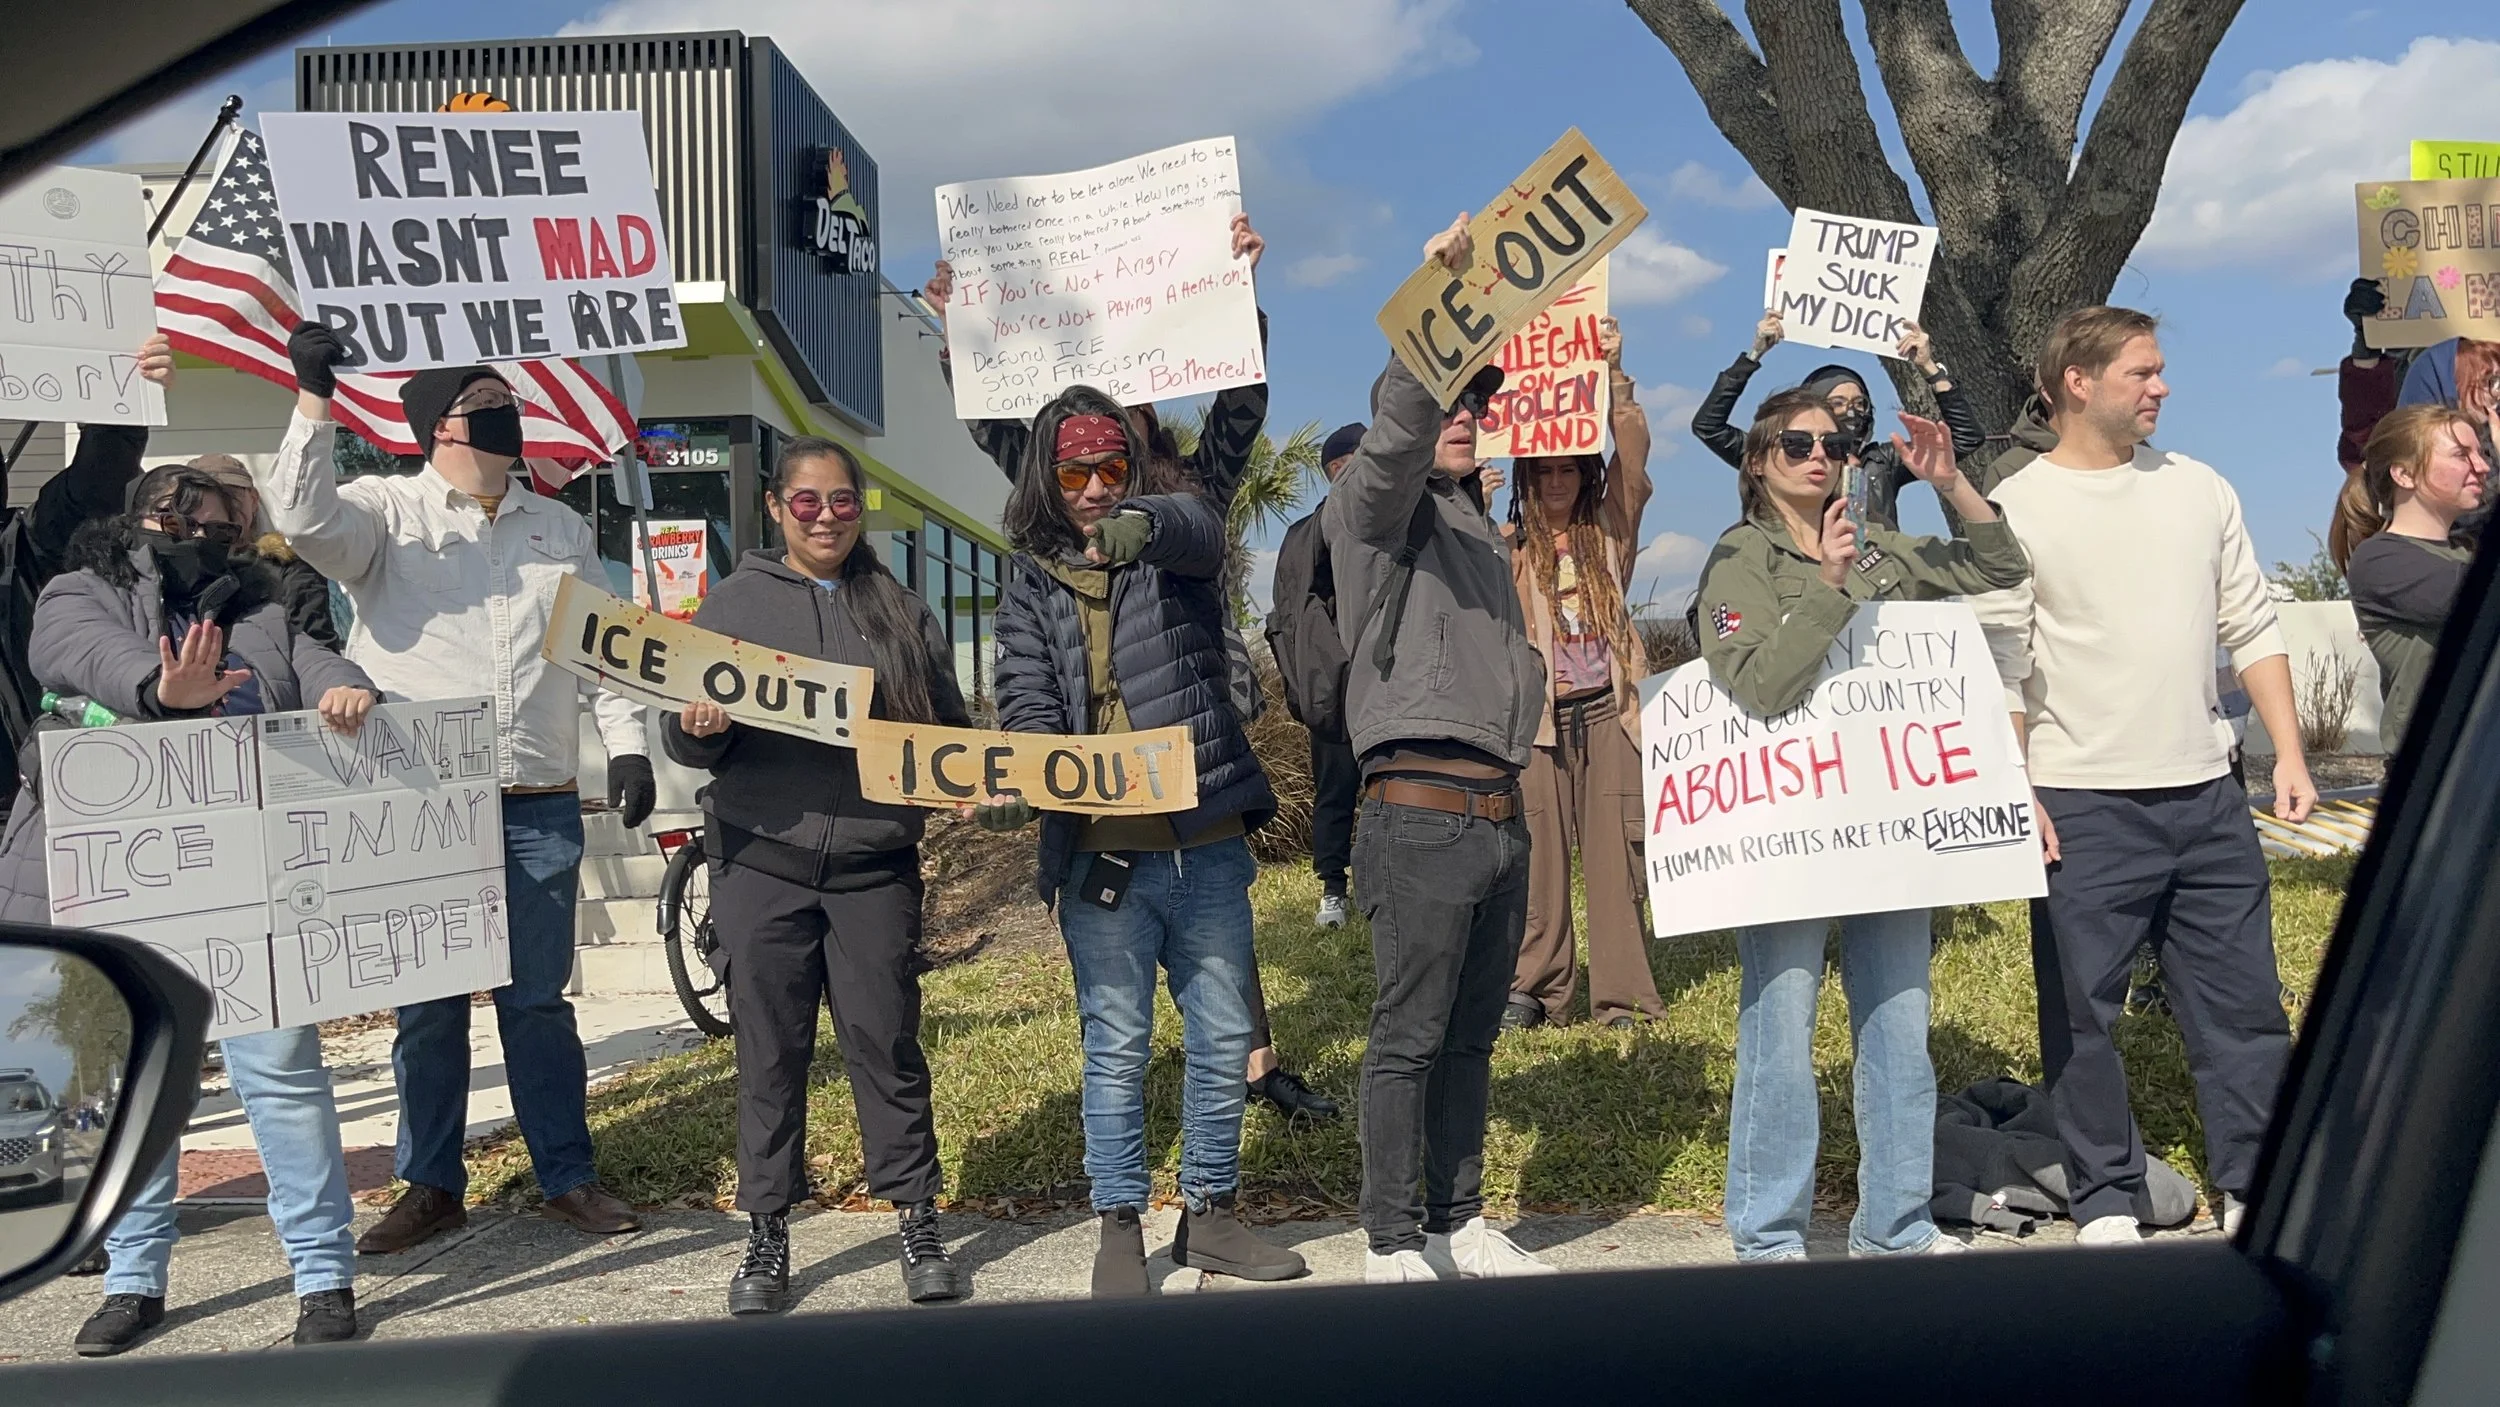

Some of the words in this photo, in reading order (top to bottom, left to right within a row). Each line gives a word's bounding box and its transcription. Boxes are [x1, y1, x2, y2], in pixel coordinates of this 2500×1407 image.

[348, 121, 588, 199] RENEE
[1026, 195, 1047, 208] not
[1051, 189, 1066, 203] to
[1070, 187, 1085, 200] be
[1088, 184, 1104, 198] let
[1137, 161, 1157, 181] We
[1161, 154, 1187, 174] need
[1191, 148, 1207, 163] to
[1215, 146, 1234, 158] be
[1069, 214, 1080, 224] in
[1085, 213, 1094, 221] a
[1165, 183, 1190, 199] long
[1196, 174, 1209, 189] is
[1213, 171, 1228, 185] it
[533, 214, 657, 280] MAD
[1116, 247, 1179, 279] Angry
[1406, 280, 1496, 383] ICE
[1495, 154, 1614, 291] OUT
[1818, 262, 1900, 304] SUCK
[317, 302, 447, 368] BUT
[462, 298, 551, 358] WE
[568, 288, 678, 350] ARE
[1781, 291, 1828, 326] MY
[1831, 302, 1907, 342] DICK
[973, 346, 1047, 373] Defund
[1054, 336, 1105, 362] ICE
[1108, 379, 1137, 398] Be
[1149, 349, 1263, 395] Bothered!
[1519, 371, 1554, 394] ON
[1479, 370, 1599, 433] STOLEN
[666, 448, 719, 466] 3105
[1510, 418, 1598, 455] LAND
[637, 530, 704, 550] SRAWBERRY
[652, 544, 688, 561] DRINKS
[1856, 550, 1883, 572] LOVE
[581, 612, 668, 685] ICE
[703, 661, 850, 738] OUT!
[1876, 629, 1958, 669] CITY
[1651, 728, 1714, 770] NOT
[1723, 710, 1750, 744] IN
[1765, 688, 1820, 734] OUR
[1828, 676, 1966, 717] COUNTRY
[51, 718, 258, 816] ONLY
[318, 709, 484, 787] WANT
[901, 738, 1022, 797] ICE
[1044, 741, 1173, 801] OUT
[1652, 731, 1849, 836] ABOLISH
[1879, 720, 1979, 791] ICE
[53, 824, 214, 913] ICE
[284, 801, 395, 870] IN
[411, 789, 488, 852] MY
[1652, 843, 1734, 884] HUMAN
[1742, 829, 1825, 863] RIGHTS
[1832, 825, 1871, 851] ARE
[1877, 818, 1924, 844] FOR
[1923, 802, 2032, 851] EVERYONE
[298, 884, 506, 1005] PEPPER
